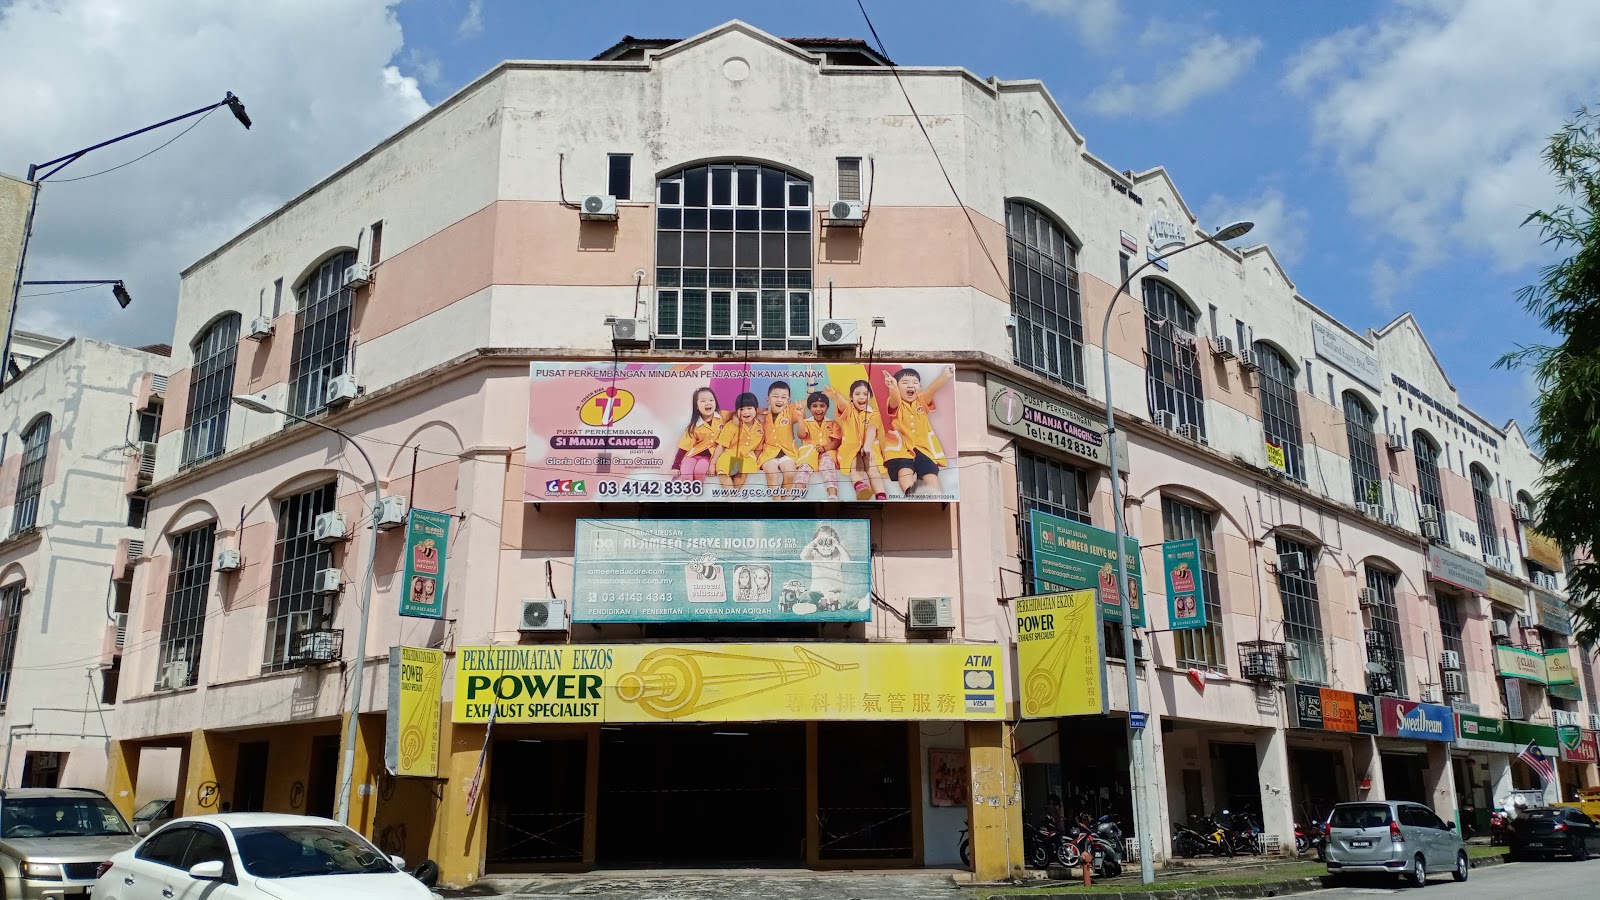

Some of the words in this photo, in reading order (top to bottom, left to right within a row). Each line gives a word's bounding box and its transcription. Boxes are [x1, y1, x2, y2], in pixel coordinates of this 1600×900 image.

[1024, 395, 1044, 409] PUSAT
[1046, 402, 1092, 427] PERKEMBANGAN
[1024, 408, 1032, 420] SI
[1034, 411, 1062, 430] MANJA
[1064, 422, 1093, 442] CANGGIH
[556, 437, 566, 446] SI
[569, 437, 606, 446] MANJA
[608, 437, 654, 446] CANGGIH
[546, 457, 572, 466] Gloria
[574, 457, 592, 466] Cita
[594, 457, 611, 466] Cita
[612, 457, 633, 466] Care
[634, 457, 663, 466] Centre
[546, 480, 586, 492] GCC
[598, 482, 617, 495] 03
[622, 482, 660, 495] 4142
[664, 482, 702, 495] 8336
[712, 487, 808, 498] www.gcc.edu.my
[1056, 526, 1073, 536] PEJABAT
[1072, 531, 1088, 540] URUSAN
[622, 537, 682, 548] AL-AMEEN
[686, 537, 721, 548] SERVE
[724, 537, 782, 548] HOLDINGS
[1058, 536, 1088, 554] AL-AMEEN
[1090, 545, 1107, 558] SERVE
[1042, 559, 1082, 572] ameeneducare.com
[602, 592, 616, 602] 03
[620, 592, 643, 602] 4143
[650, 592, 673, 602] 4343
[1017, 614, 1054, 634] POWER
[1018, 632, 1034, 642] EXHAUST
[1034, 630, 1055, 641] SPECIALIST
[462, 650, 563, 671] PERKHIDMATAN
[572, 648, 613, 670] EKZOS
[964, 656, 992, 667] ATM
[402, 664, 423, 682] POWER
[466, 674, 603, 700] POWER
[466, 703, 524, 718] EXHAUST
[528, 702, 600, 718] SPECIALIST
[1339, 708, 1354, 719] EXPO
